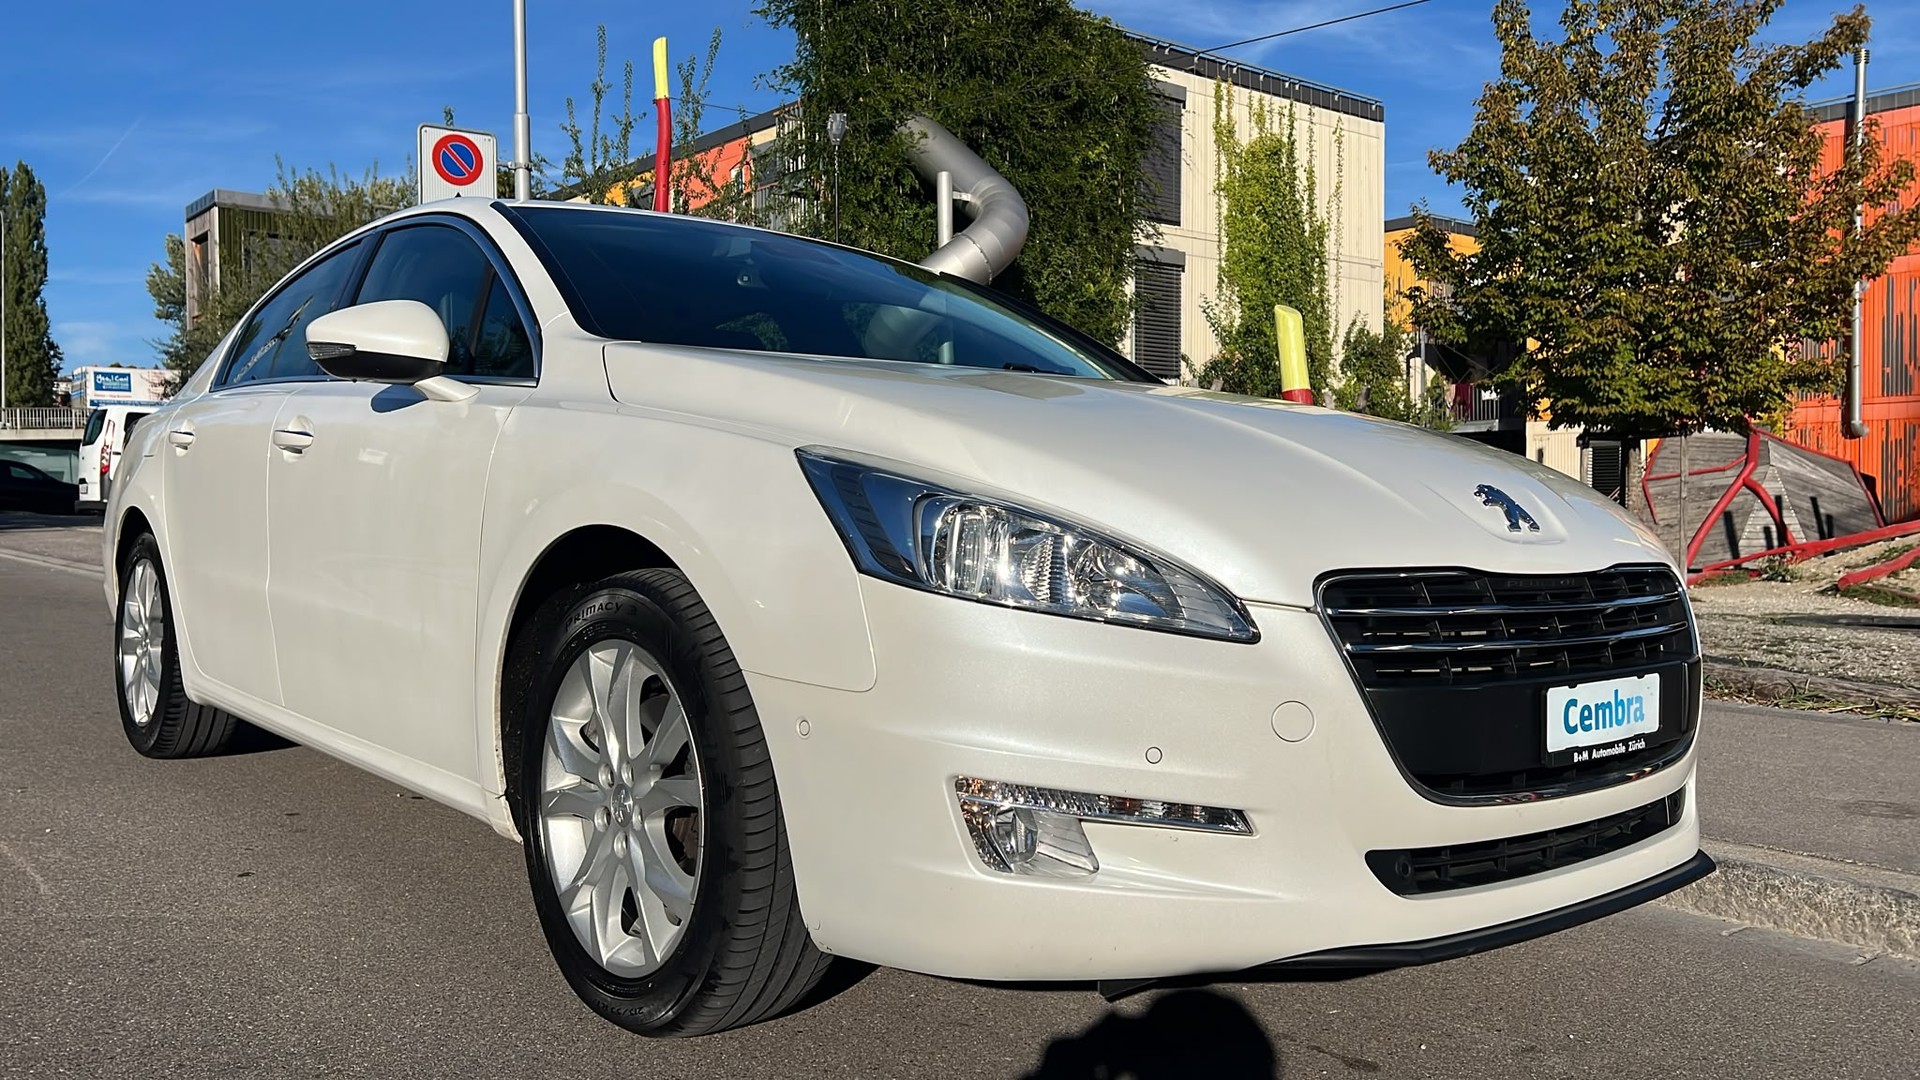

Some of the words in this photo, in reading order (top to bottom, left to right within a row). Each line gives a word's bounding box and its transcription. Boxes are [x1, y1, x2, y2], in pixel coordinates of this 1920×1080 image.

[565, 602, 623, 632] PRIMACY
[1563, 689, 1645, 735] Cembra
[1573, 750, 1589, 763] B+M
[1592, 742, 1626, 759] Automobile
[1628, 738, 1645, 752] Zürich
